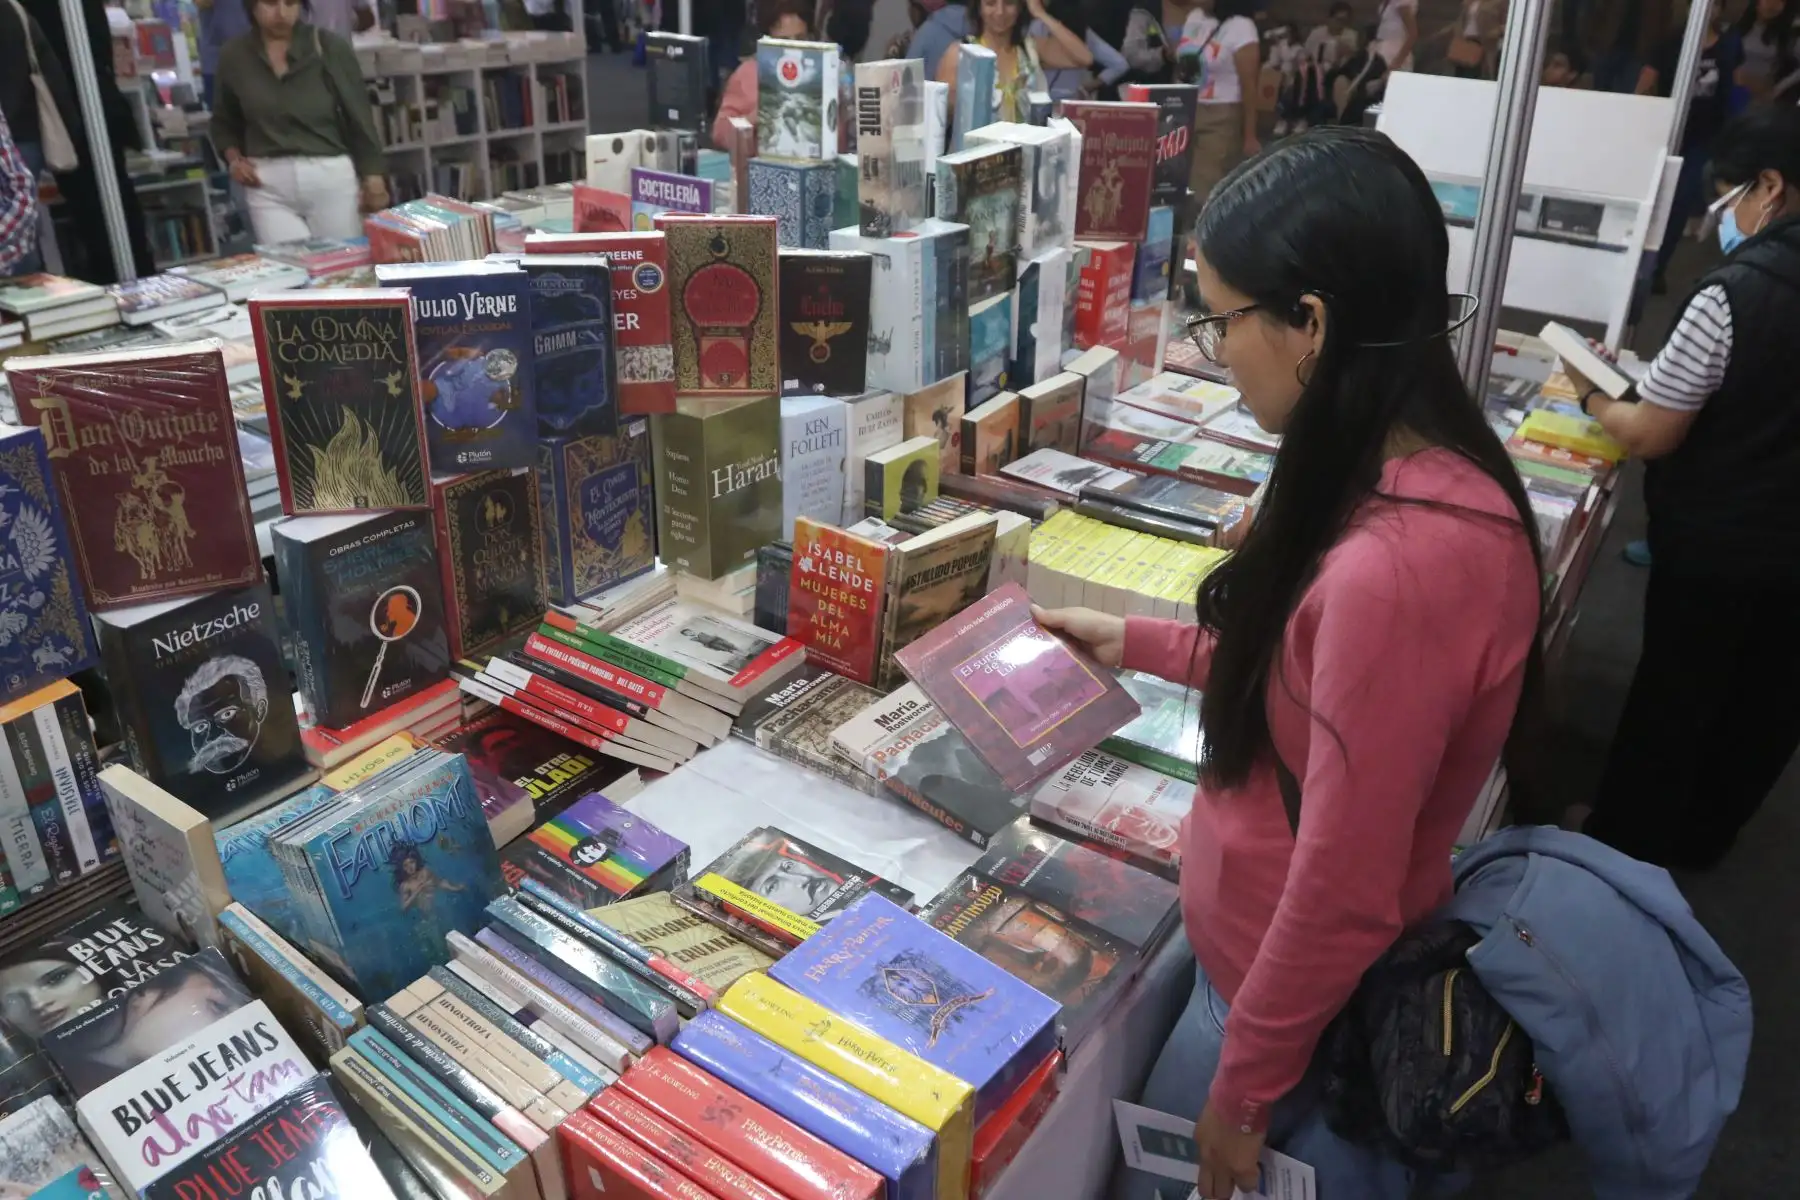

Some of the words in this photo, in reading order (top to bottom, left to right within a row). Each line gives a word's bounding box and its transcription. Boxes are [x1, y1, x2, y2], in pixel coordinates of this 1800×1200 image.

[859, 87, 881, 136] DUNE
[639, 177, 700, 205] COCTELERÍA
[411, 295, 457, 323] JULIO
[458, 291, 517, 321] VERNE
[276, 321, 307, 343] LA
[311, 316, 398, 342] DIVINA
[534, 330, 577, 355] GRIMM
[278, 340, 403, 365] COMEDIA
[30, 397, 114, 460] Don
[121, 406, 219, 448] Quijote
[805, 415, 829, 436] KEN
[89, 455, 109, 477] de
[114, 451, 135, 473] la
[160, 442, 225, 468] Mancha
[665, 447, 690, 463] Sapiens
[791, 428, 842, 459] FOLLETT
[712, 448, 780, 500] Harari
[328, 540, 361, 557] OBRAS
[362, 520, 416, 545] COMPLETAS
[808, 540, 865, 574] ISABEL
[800, 578, 867, 611] MUJERES
[818, 599, 846, 619] DEL
[152, 602, 260, 659] Nietzsche
[637, 620, 677, 645] Fujimori
[810, 613, 850, 638] ALMA
[816, 628, 842, 650] MÍA
[561, 653, 569, 663] LA
[616, 676, 629, 690] BILL
[627, 680, 645, 695] GATES
[960, 664, 974, 678] El
[762, 676, 851, 734] Pachacamac
[764, 677, 810, 705] María
[774, 670, 834, 709] Rostworowski
[873, 698, 920, 729] María
[885, 701, 934, 734] Rostworow
[872, 713, 946, 764] Pachacu
[341, 756, 387, 786] HIJOS
[386, 745, 405, 761] DE
[513, 775, 535, 789] EL
[533, 752, 572, 776] OTRO
[524, 754, 596, 801] VLADI
[1062, 750, 1099, 784] REBELION
[1079, 775, 1094, 788] DE
[1088, 755, 1115, 781] TUPAC
[1101, 761, 1129, 788] AMARU
[322, 773, 467, 900] FATHOM
[719, 887, 748, 907] conflicto
[809, 908, 820, 919] LA
[818, 896, 838, 913] GUERRA
[834, 887, 846, 901] DEL
[942, 885, 1003, 939] ANTINSUYU
[67, 917, 138, 963] BLUE
[624, 913, 709, 945] RAICIONES
[75, 927, 165, 985] JEANS
[644, 932, 741, 965] ERUANA
[803, 942, 853, 985] HARRY
[844, 915, 895, 951] POTTER
[117, 958, 150, 979] LA
[377, 1009, 409, 1038] escritura
[416, 1012, 471, 1056] HINOSTROZA
[438, 997, 493, 1041] HINOSTROZA
[411, 1036, 425, 1050] de
[422, 1044, 448, 1068] cocina
[836, 1036, 867, 1060] HARRY
[864, 1048, 899, 1074] POTTER
[111, 1073, 191, 1138] BLUE
[188, 1021, 280, 1093] JEANS
[441, 1062, 457, 1077] La
[648, 1063, 664, 1079] J.K.
[661, 1071, 701, 1101] ROWLING
[251, 1117, 266, 1132] para
[264, 1105, 284, 1121] Paula
[607, 1098, 625, 1114] J.K.
[622, 1106, 665, 1138] ROWLING
[594, 1128, 635, 1159] ROWLING
[740, 1116, 774, 1144] HARRY
[770, 1131, 809, 1164] POTTER
[172, 1144, 262, 1200] BLUE
[703, 1156, 736, 1184] HARRY
